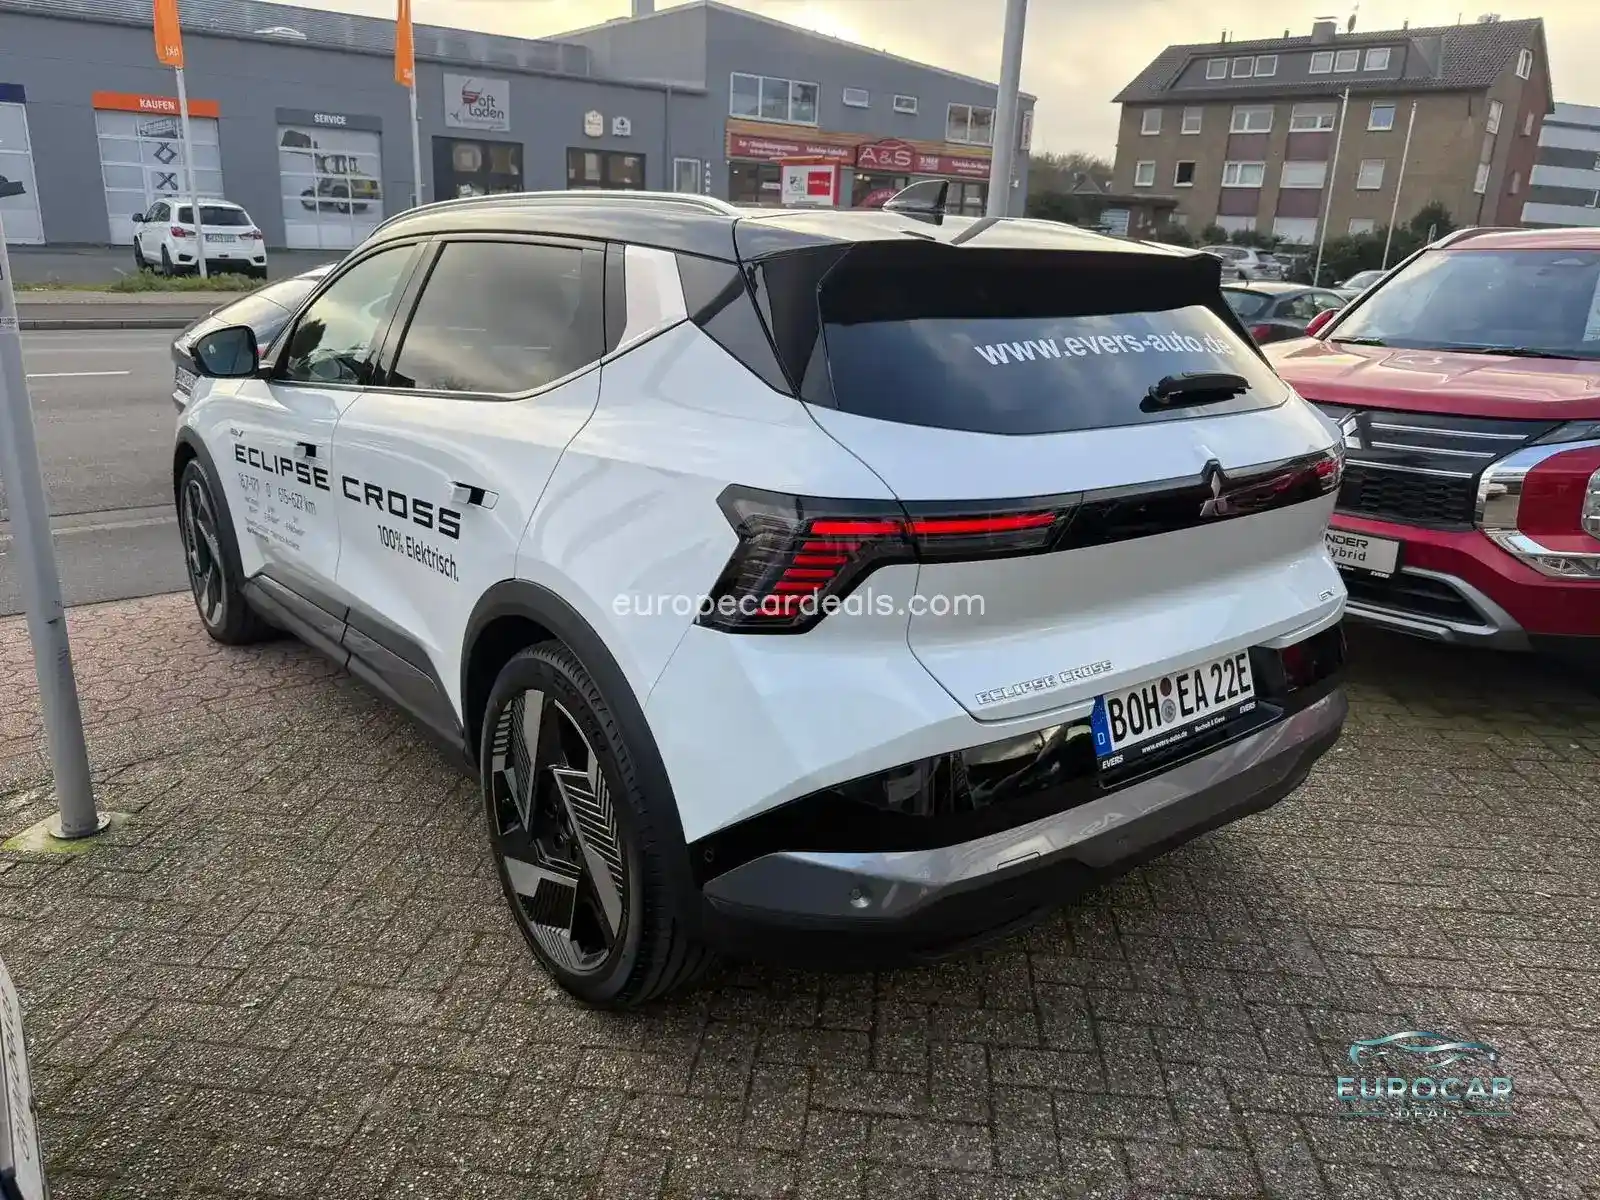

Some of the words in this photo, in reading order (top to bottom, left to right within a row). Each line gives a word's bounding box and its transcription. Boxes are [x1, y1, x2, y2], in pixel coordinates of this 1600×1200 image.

[139, 98, 175, 110] KAUFEN
[313, 113, 347, 126] SERVICE
[859, 147, 913, 166] A&S
[974, 331, 1231, 366] www.evers-auto.de
[234, 443, 330, 492] ECLIPSE
[341, 475, 461, 540] CROSS
[377, 524, 405, 554] 100%
[406, 535, 460, 582] Elektrisch.
[975, 674, 1056, 705] ECLIPSE
[1058, 659, 1114, 684] CROSS
[1108, 684, 1162, 743] BOH
[1175, 673, 1209, 717] EA
[1210, 652, 1252, 704] 22E
[1239, 701, 1256, 714] EVERS
[1102, 754, 1124, 770] EVERS
